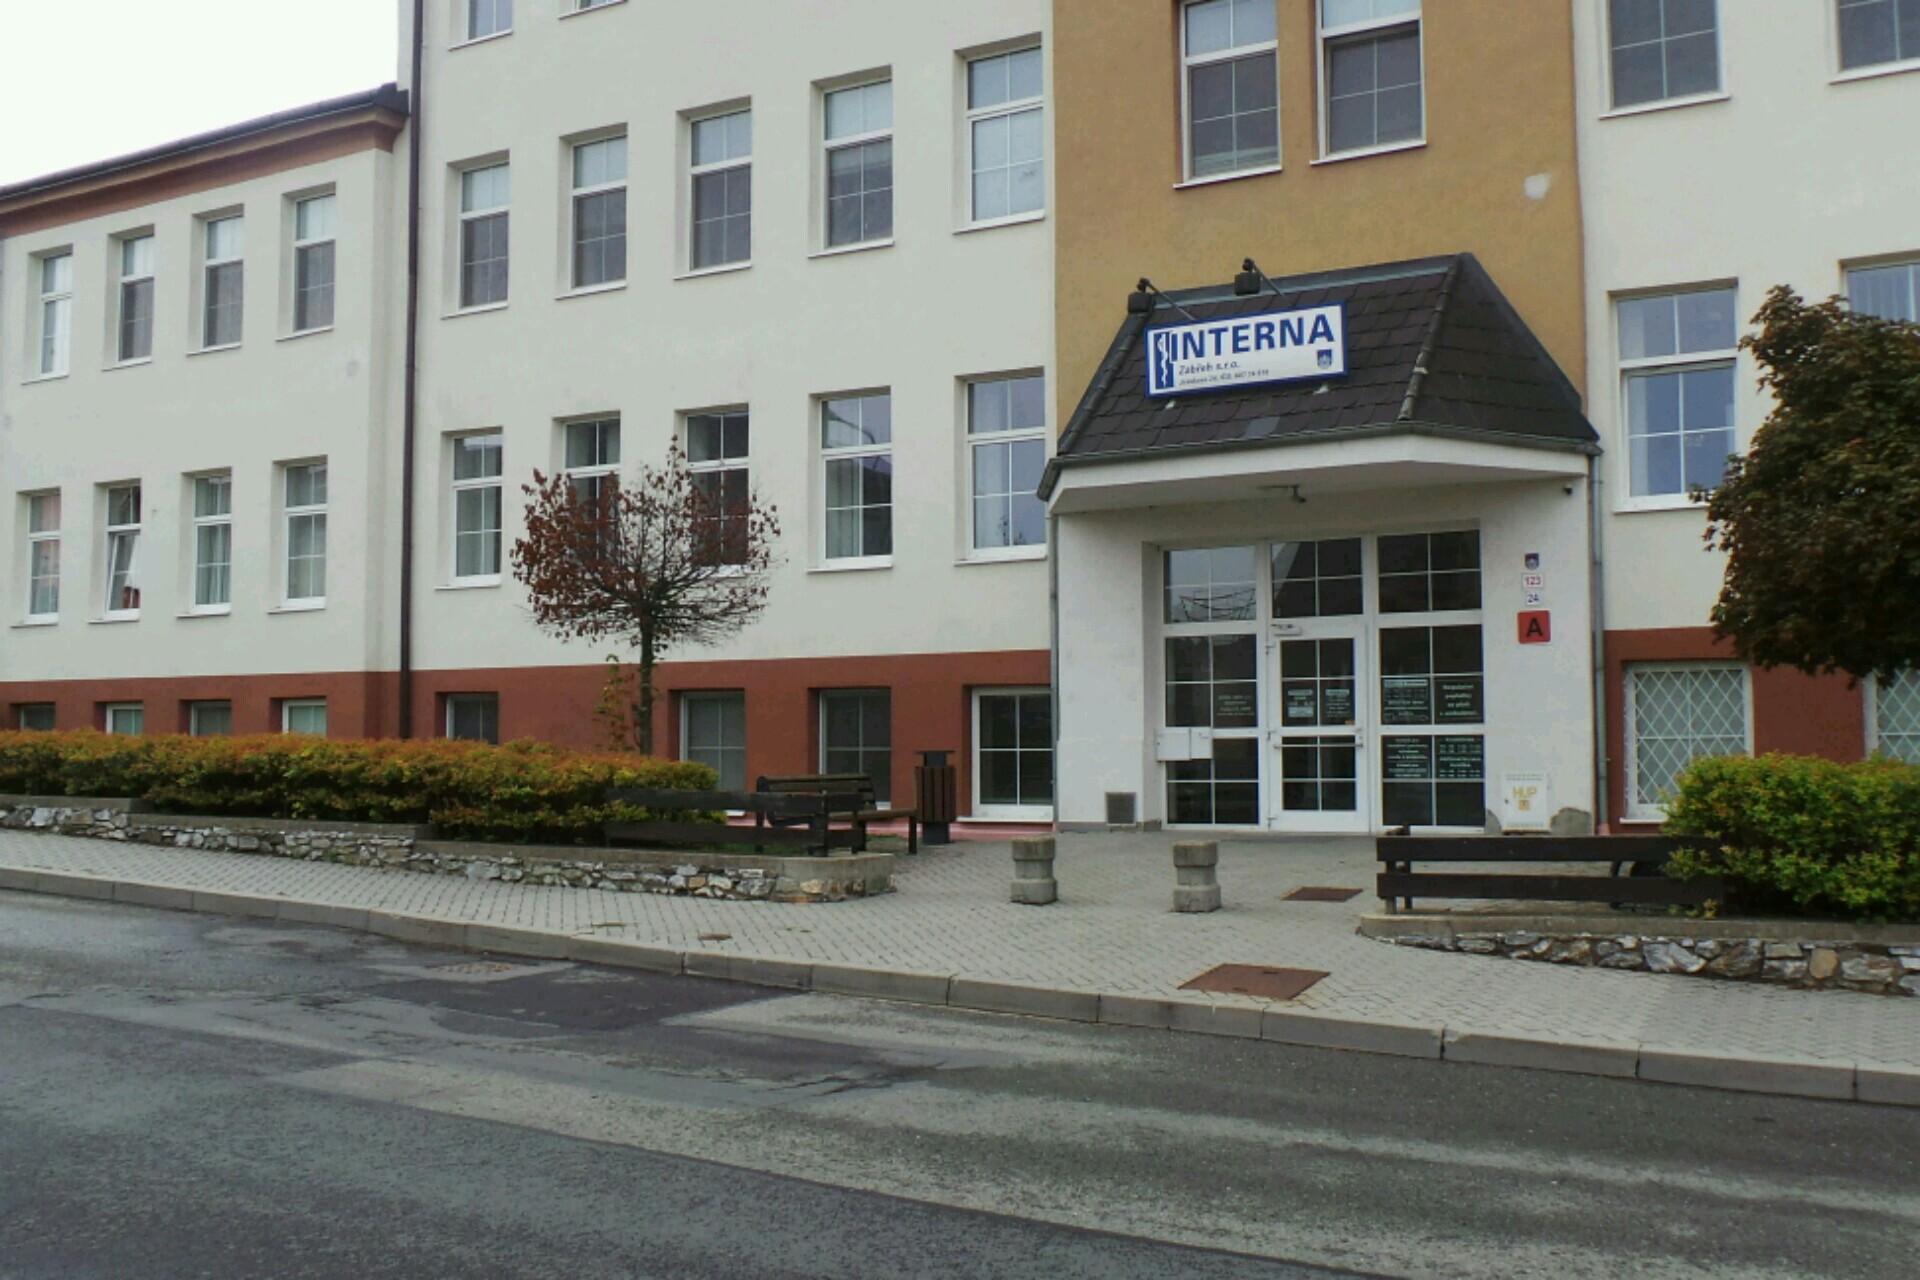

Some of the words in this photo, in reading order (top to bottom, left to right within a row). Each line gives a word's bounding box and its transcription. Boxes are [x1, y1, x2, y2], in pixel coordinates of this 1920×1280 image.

[1171, 313, 1336, 362] INTERNA
[1525, 576, 1541, 586] 123
[1528, 594, 1539, 603] 24
[1526, 617, 1544, 637] A
